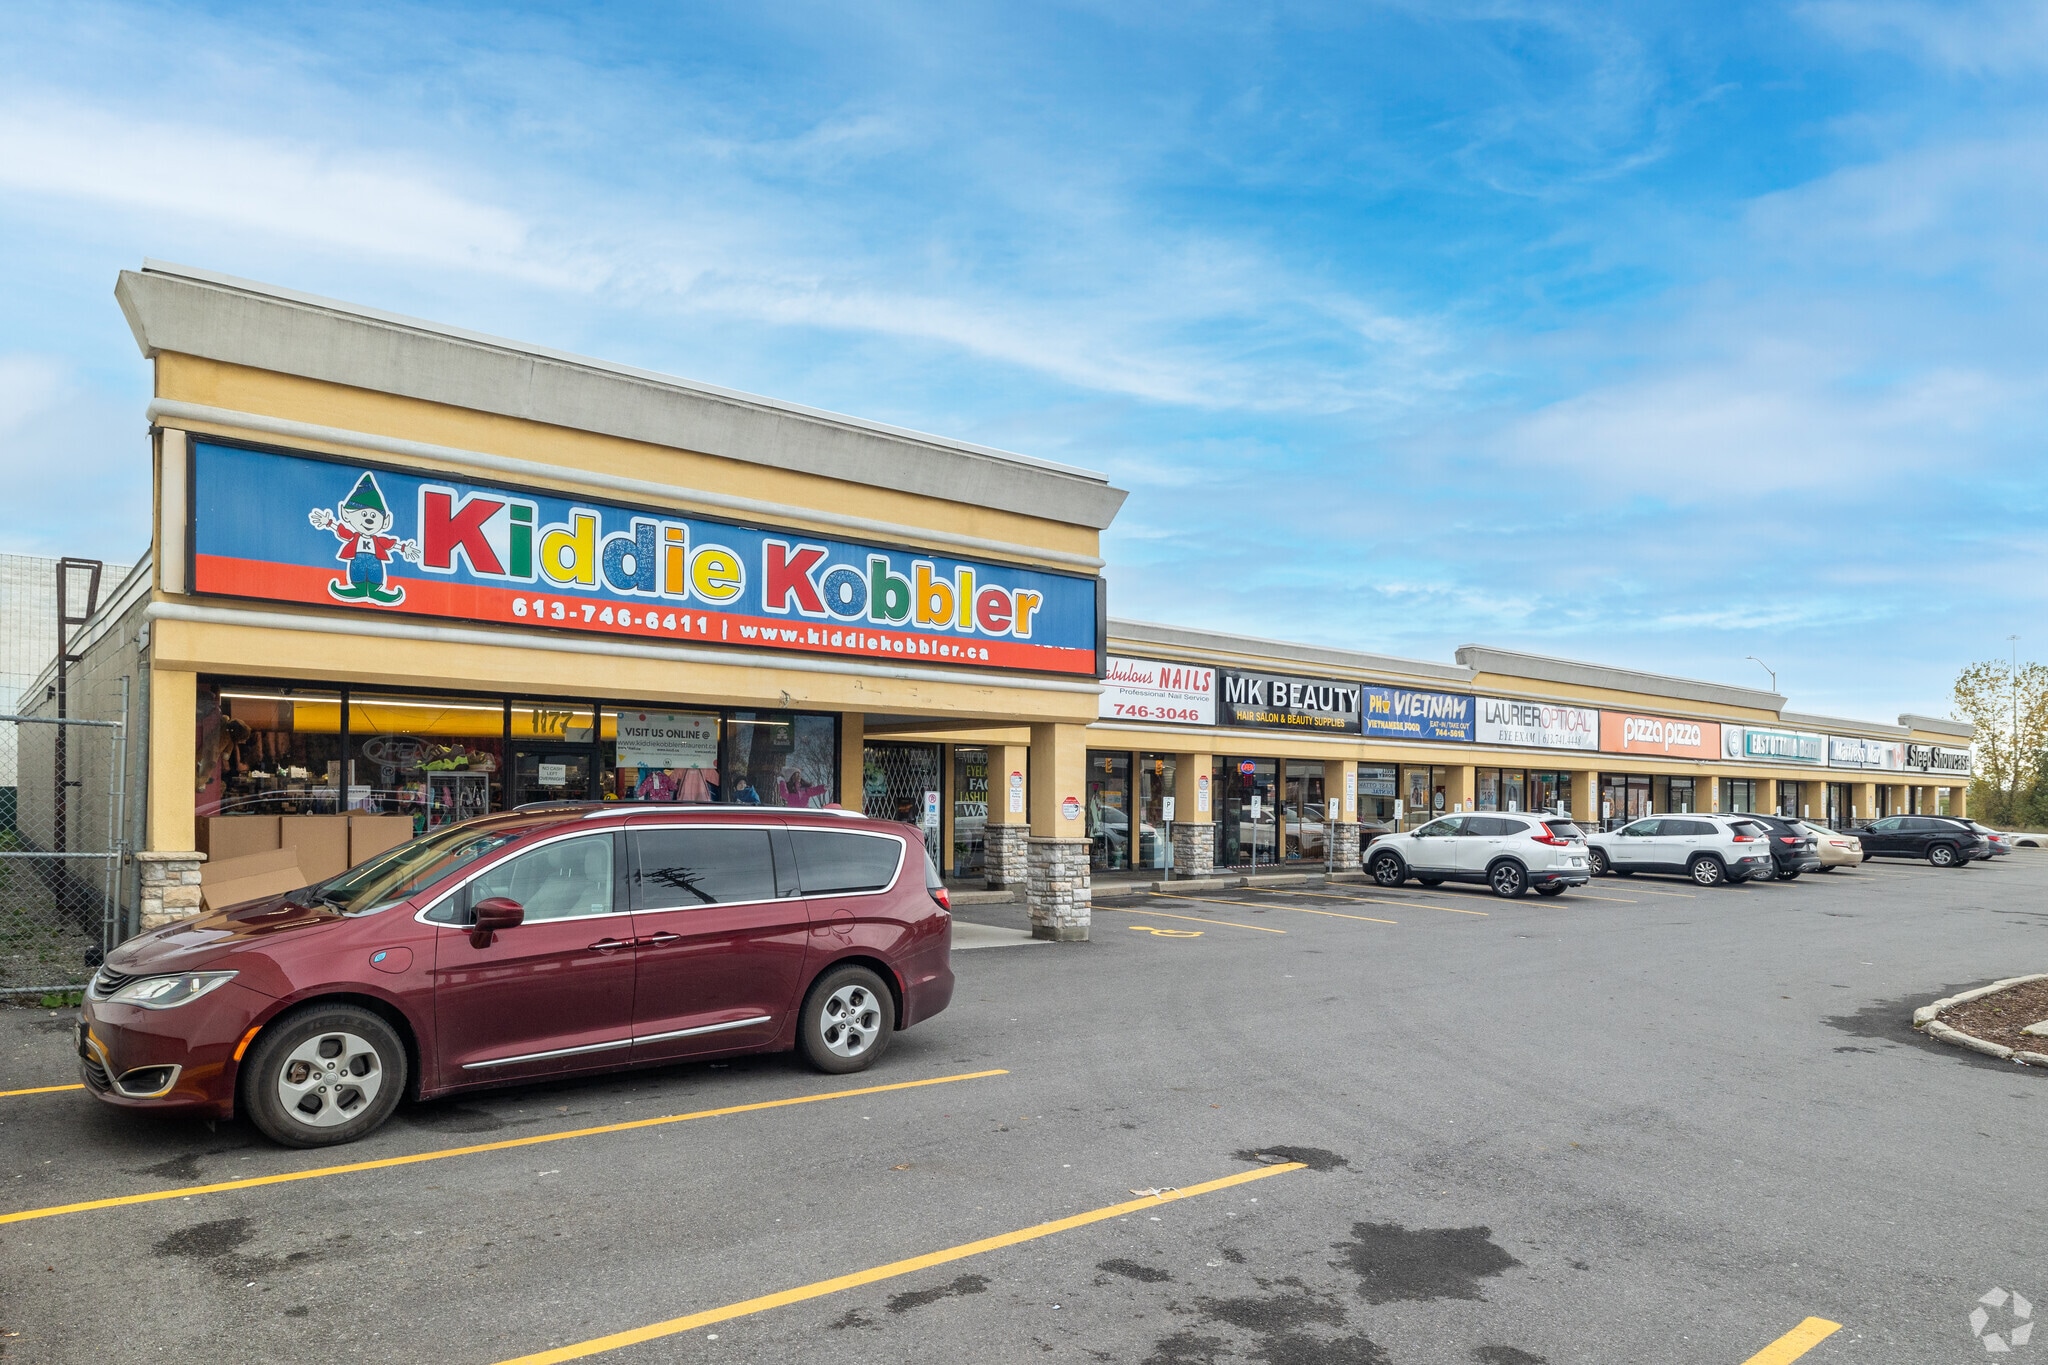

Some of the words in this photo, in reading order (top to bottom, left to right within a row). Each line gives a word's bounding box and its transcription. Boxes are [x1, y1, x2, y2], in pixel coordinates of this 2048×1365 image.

[361, 540, 372, 551] K
[420, 487, 743, 602] Kiddie
[764, 541, 1041, 638] Kobbler
[512, 598, 709, 635] 613-746-6411
[739, 622, 990, 661] www.kiddiekobbler.ca
[1105, 660, 1153, 684] abulous
[1159, 666, 1212, 692] NAILS
[1119, 688, 1166, 698] Professional
[1168, 692, 1182, 700] Nail
[1183, 694, 1210, 702] Service
[1225, 676, 1264, 705] MK
[1273, 681, 1360, 713] BEAUTY
[1113, 703, 1199, 722] 746-3046
[1394, 690, 1467, 720] VIETNAM
[532, 709, 574, 734] 1177
[1236, 711, 1254, 721] HAIR
[1256, 712, 1279, 723] SALON
[1287, 714, 1313, 726] BEAUTY
[1314, 716, 1345, 728] SUPPLIES
[1368, 720, 1404, 731] VIETNAMESE
[1405, 722, 1420, 732] FOOD
[625, 727, 649, 737] VISIT
[651, 729, 664, 738] US
[666, 729, 700, 739] ONLINE
[1499, 730, 1513, 742] EYE
[1515, 731, 1536, 743] EXAM
[962, 752, 987, 763] MICRO
[1908, 744, 1932, 771] Sleep
[1932, 746, 1970, 770] Showcase
[966, 765, 988, 776] EYELA
[969, 778, 988, 790] FAC
